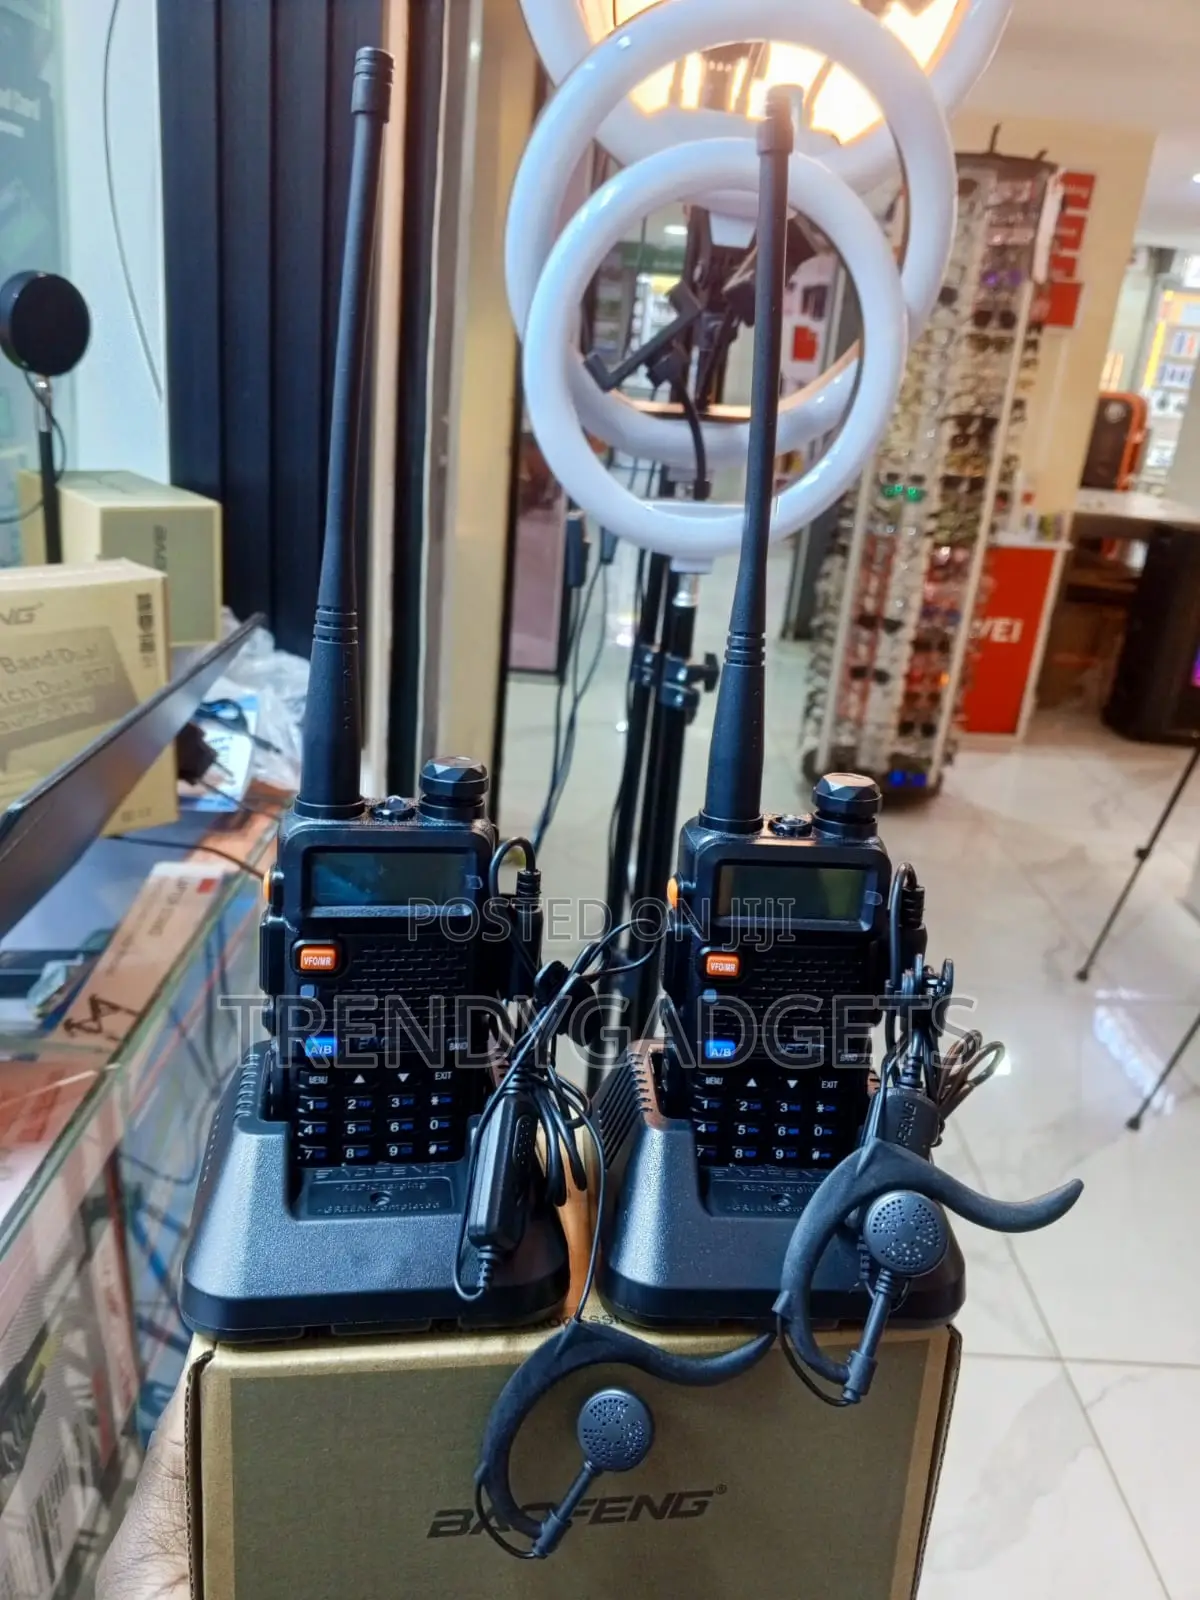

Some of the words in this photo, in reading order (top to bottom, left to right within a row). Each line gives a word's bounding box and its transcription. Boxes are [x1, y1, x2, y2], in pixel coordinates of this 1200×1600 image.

[710, 1048, 731, 1057] A/B
[309, 1076, 328, 1084] MENU
[435, 1071, 452, 1080] EXIT
[705, 1077, 723, 1085] MENU
[821, 1080, 838, 1089] EXIT
[306, 1100, 314, 1110] 1
[348, 1099, 356, 1109] 2
[391, 1098, 400, 1107] 3
[701, 1100, 708, 1109] 1
[739, 1101, 748, 1111] 2
[780, 1103, 788, 1112] 3
[304, 1125, 313, 1134] 4
[347, 1124, 356, 1134] 5
[390, 1122, 399, 1132] 6
[429, 1120, 439, 1130] 0
[697, 1123, 706, 1133] 4
[737, 1125, 746, 1135] 5
[778, 1126, 786, 1136] 6
[814, 1126, 822, 1136] 0
[304, 1150, 313, 1159] 7
[345, 1149, 354, 1158] 8
[389, 1146, 398, 1156] 9
[696, 1147, 704, 1156] 7
[735, 1149, 743, 1158] 8
[775, 1149, 784, 1159] 9
